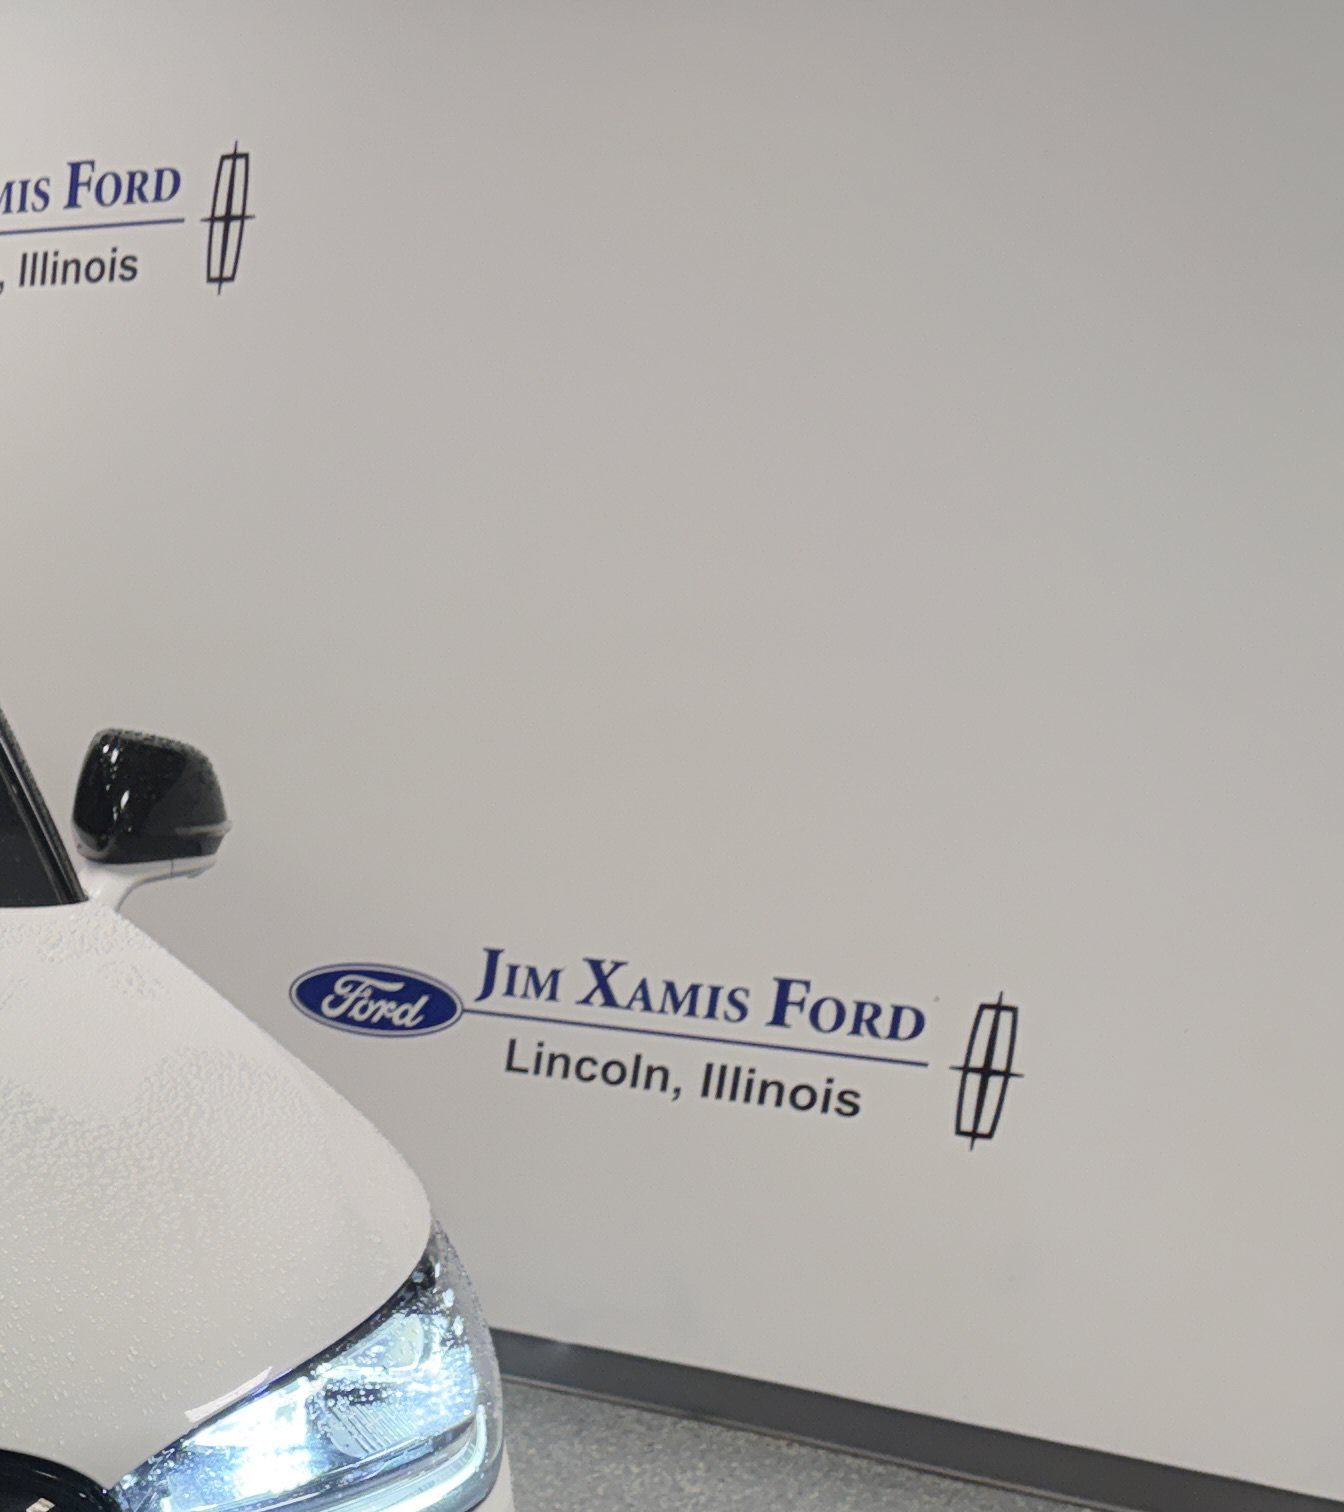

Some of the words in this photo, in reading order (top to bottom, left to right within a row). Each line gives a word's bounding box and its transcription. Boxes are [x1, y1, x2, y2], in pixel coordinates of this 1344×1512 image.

[64, 160, 180, 208] FORD
[20, 247, 137, 286] Illinois
[321, 974, 424, 1029] Ford
[475, 948, 561, 1002] JIM
[575, 958, 749, 1023] XAMIS
[765, 978, 925, 1041] FORD
[505, 1038, 682, 1100] Lincoln,
[700, 1062, 861, 1117] Illinois
